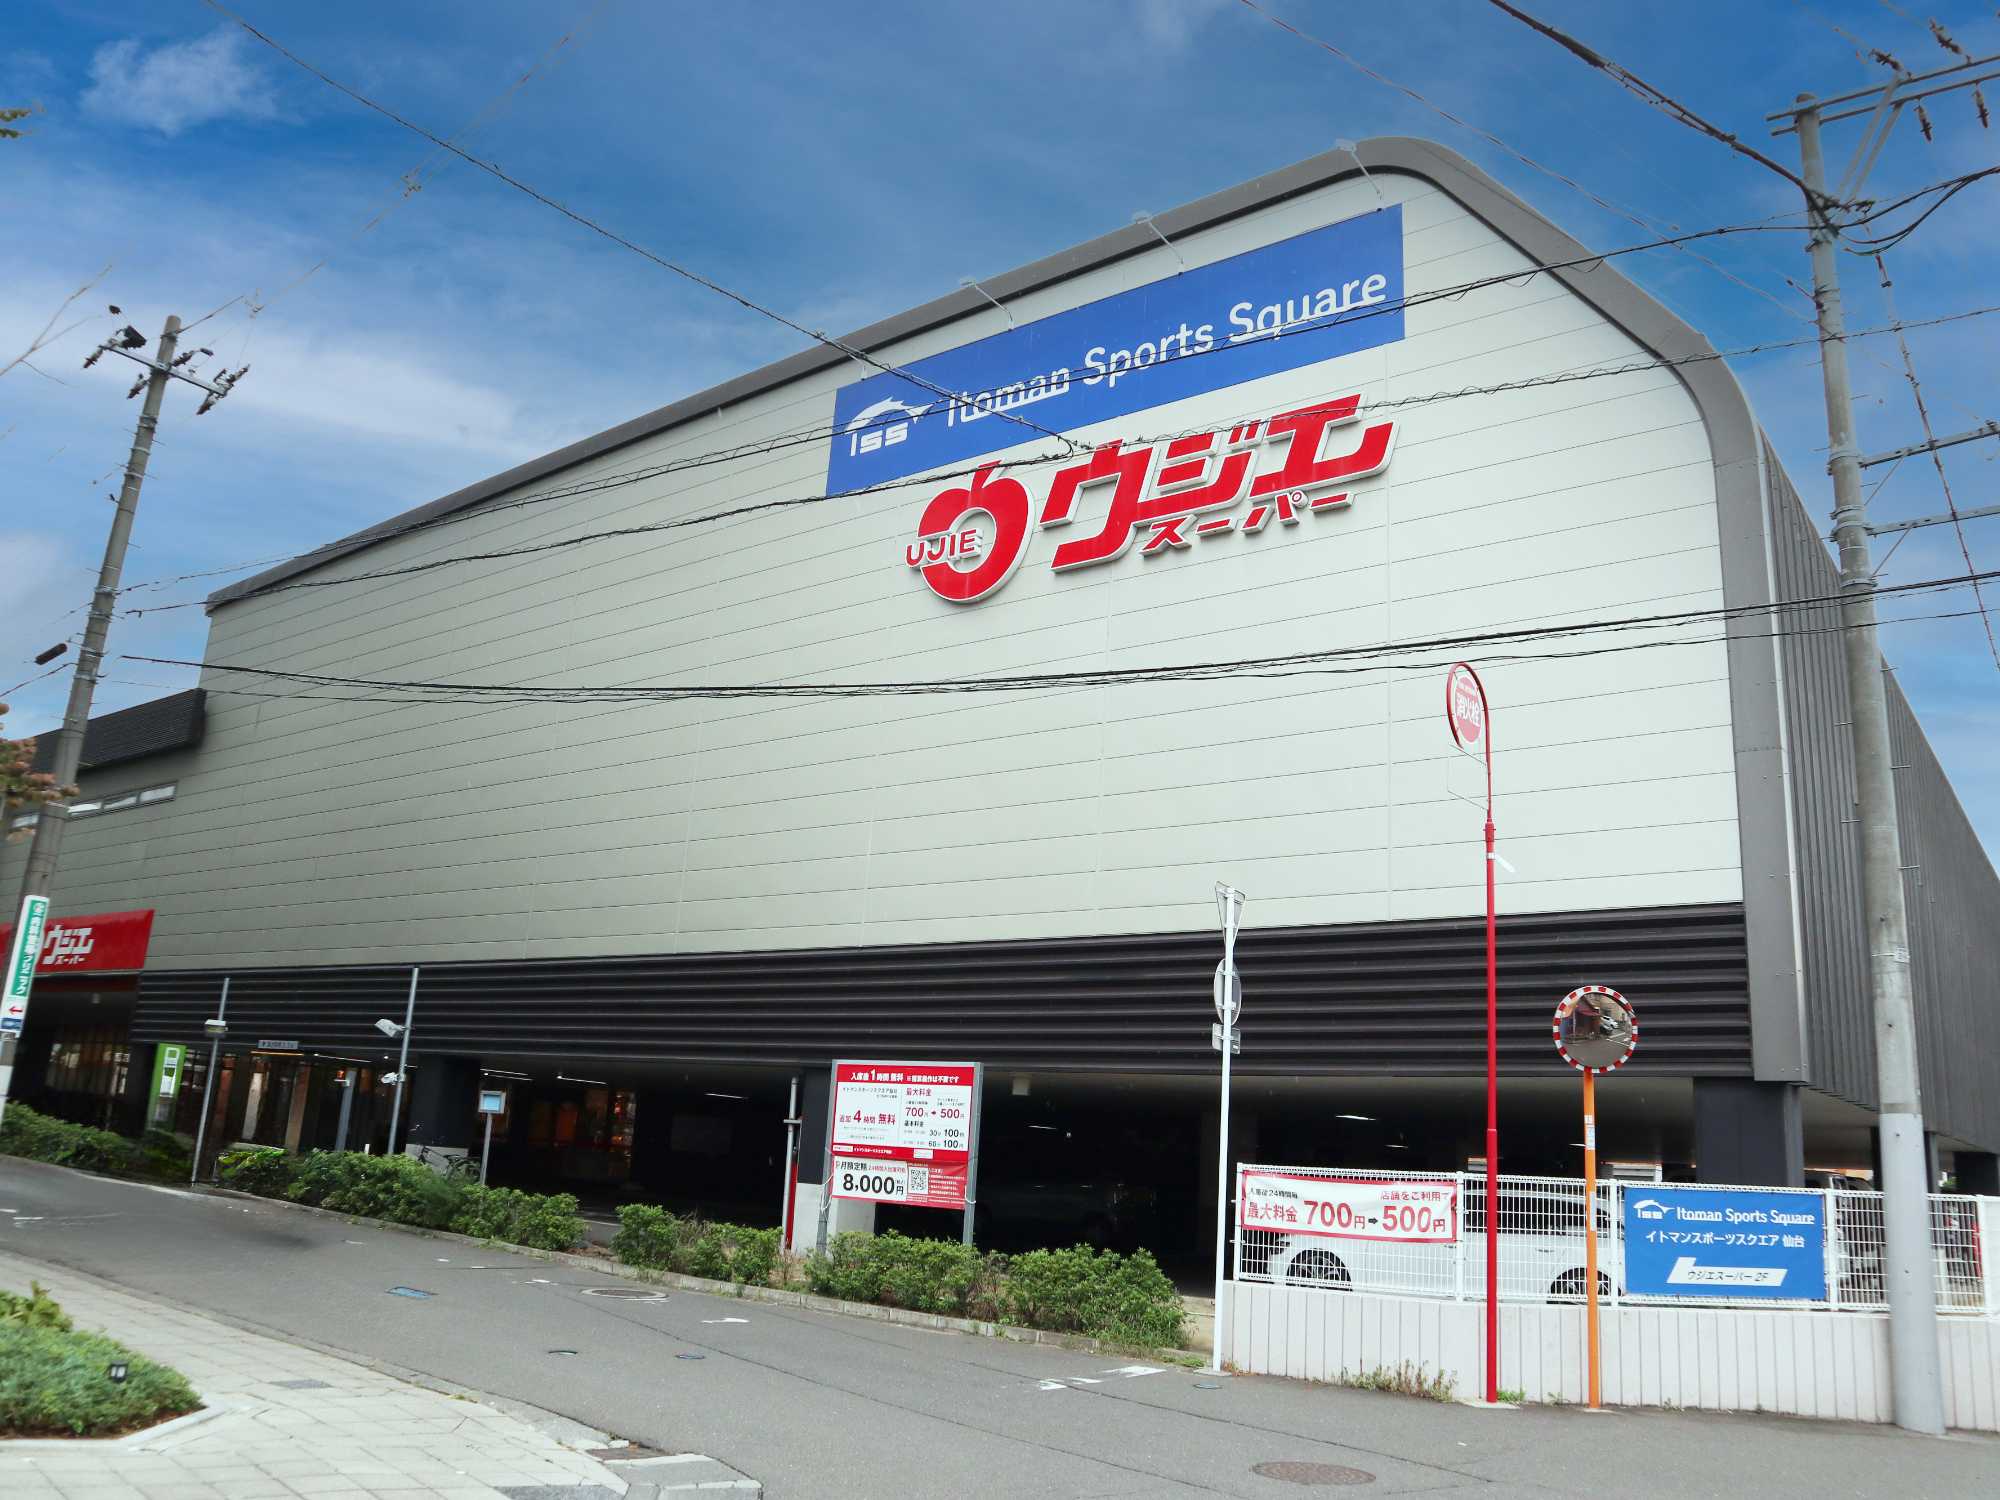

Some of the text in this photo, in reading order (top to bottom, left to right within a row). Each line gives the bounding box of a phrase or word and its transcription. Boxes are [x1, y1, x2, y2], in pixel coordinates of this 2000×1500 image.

[947, 272, 1387, 428] Itoman Sports Square
[1040, 393, 1399, 571] ウジエ
[1140, 489, 1355, 556] スーパー
[905, 528, 983, 568] UJIE
[905, 1087, 932, 1097] 最大料金
[1247, 1201, 1298, 1223] 最大料金
[1676, 1206, 1816, 1226] Itoman Sports Square
